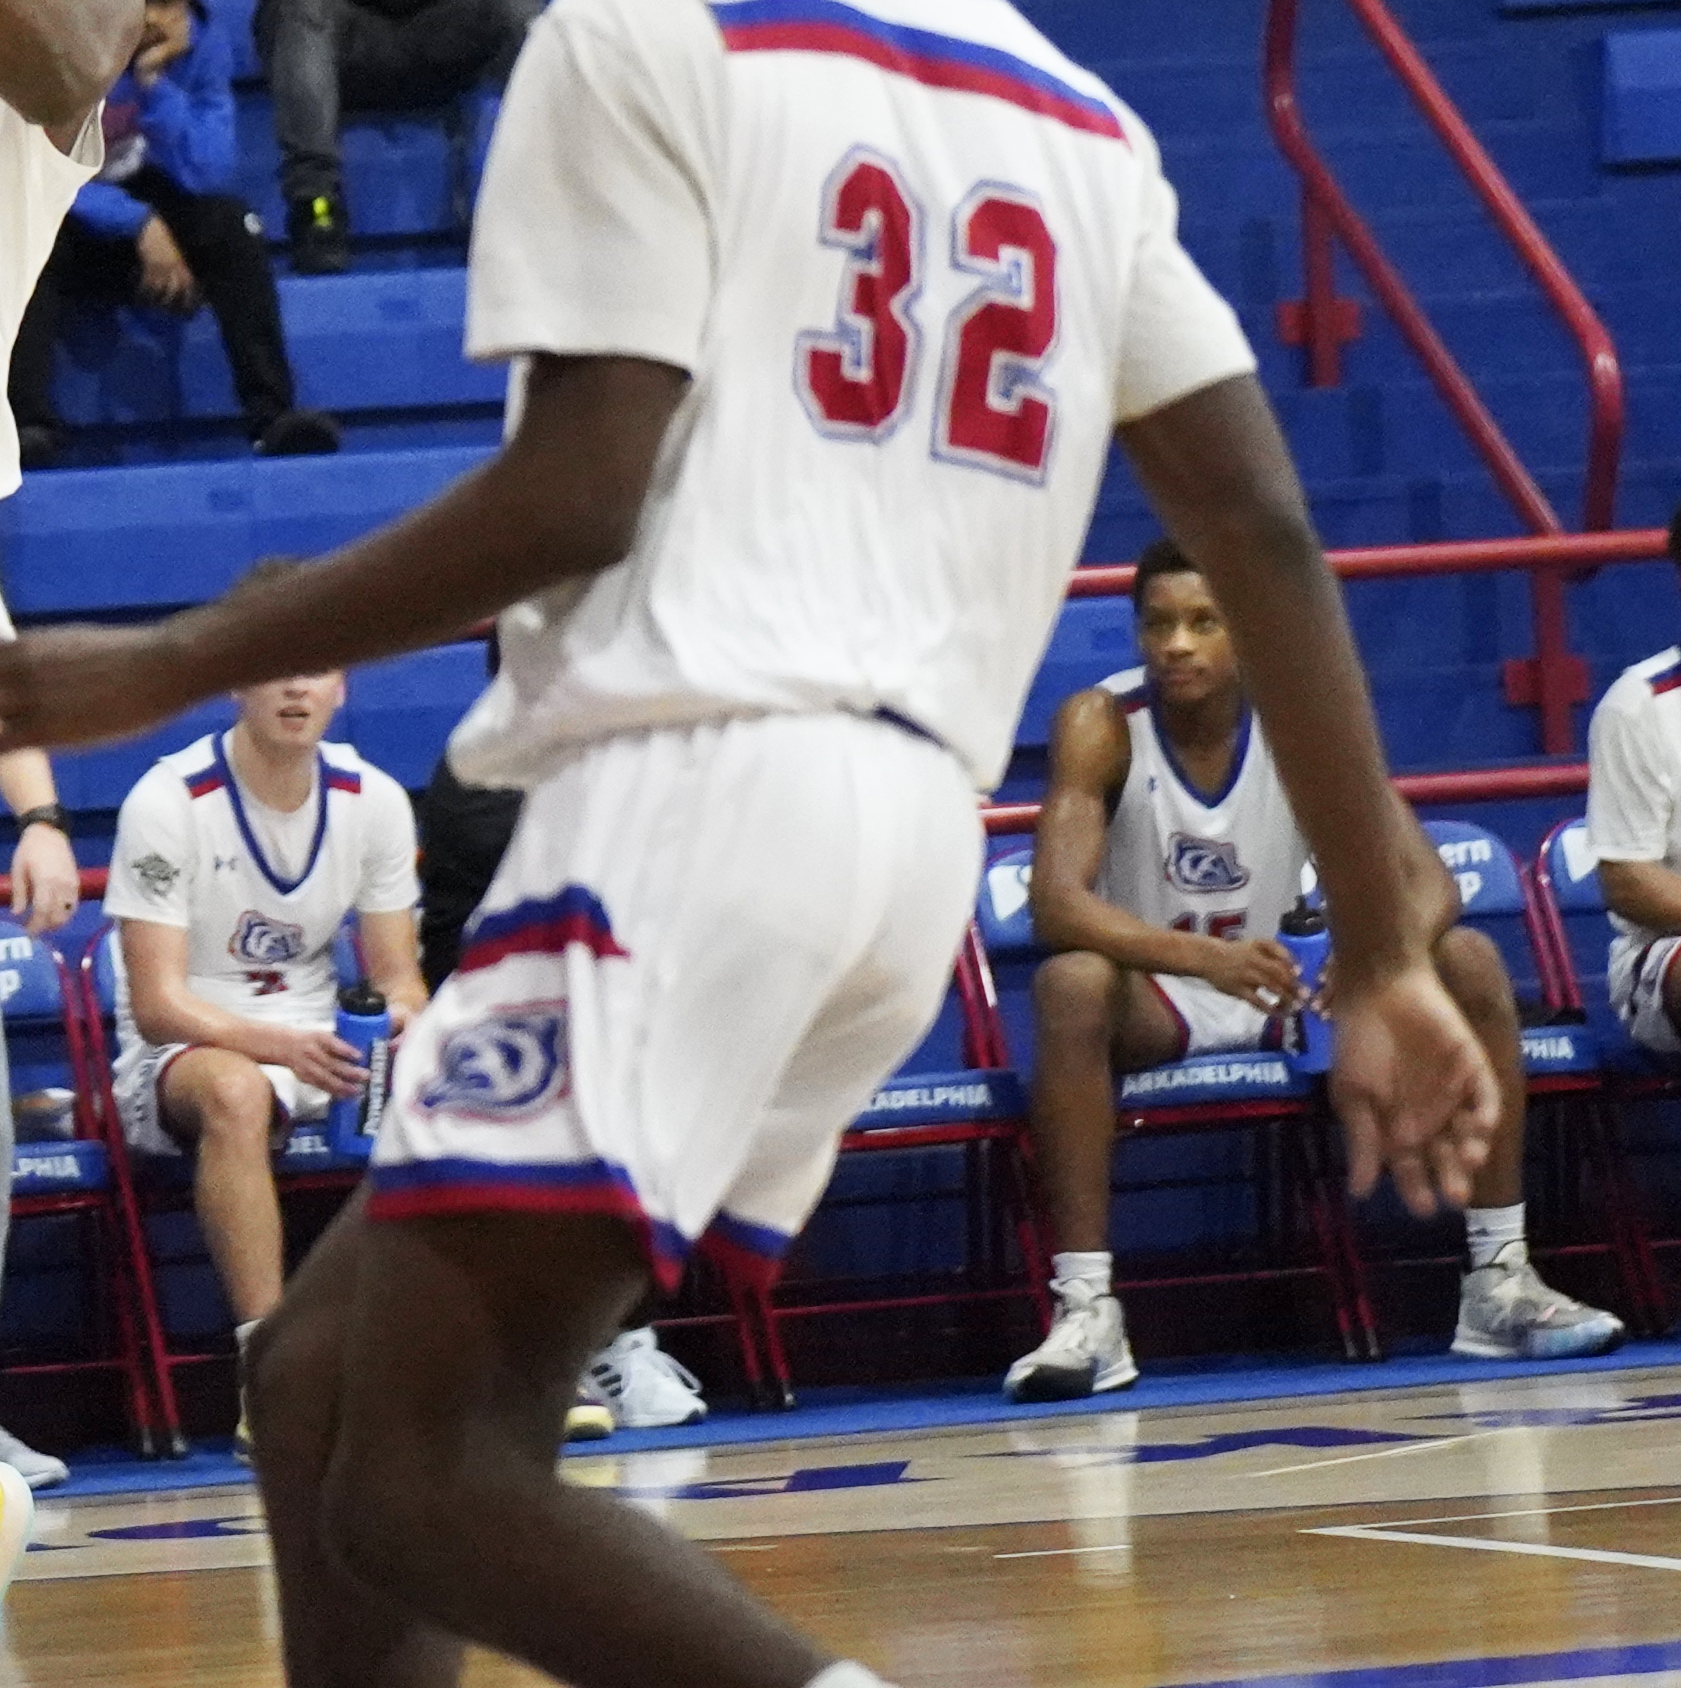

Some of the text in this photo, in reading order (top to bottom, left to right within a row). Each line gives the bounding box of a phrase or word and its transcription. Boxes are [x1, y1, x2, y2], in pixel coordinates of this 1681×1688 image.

[792, 140, 1061, 489] 32
[864, 1083, 994, 1111] ADELPHIA
[1121, 1060, 1290, 1100] ARKADELPHIA
